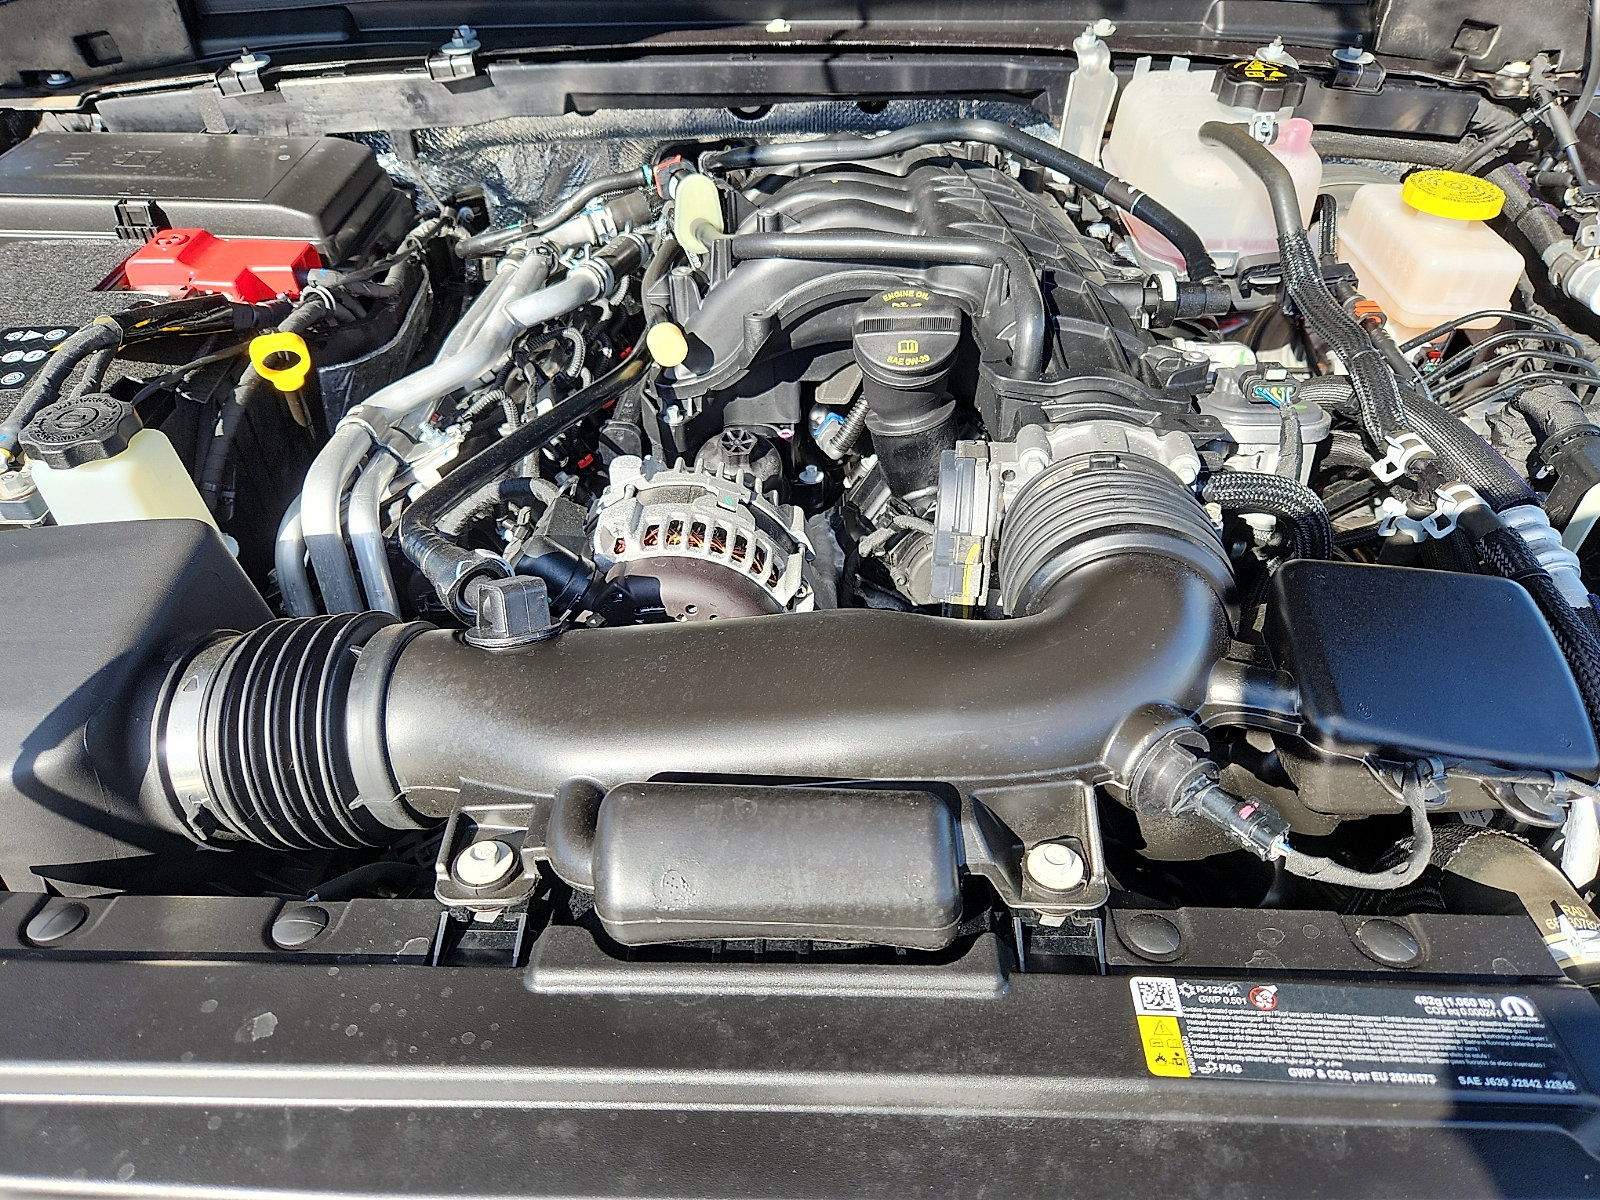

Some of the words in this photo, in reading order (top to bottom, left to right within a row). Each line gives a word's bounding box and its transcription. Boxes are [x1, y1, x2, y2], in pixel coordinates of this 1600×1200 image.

[882, 290, 914, 302] ENGINE
[915, 291, 930, 301] OIL
[886, 355, 904, 366] SAE
[905, 354, 931, 366] 0W-20
[1198, 995, 1222, 1004] GWP
[1223, 996, 1247, 1005] 0.501
[1424, 1005, 1447, 1016] CO2
[1219, 1064, 1243, 1074] PAG
[1287, 1067, 1316, 1079] GWP
[1316, 1069, 1327, 1079] &
[1326, 1069, 1351, 1081] CO2
[1351, 1072, 1370, 1083] per
[1370, 1072, 1389, 1082] EU
[1458, 1075, 1483, 1086] SAE
